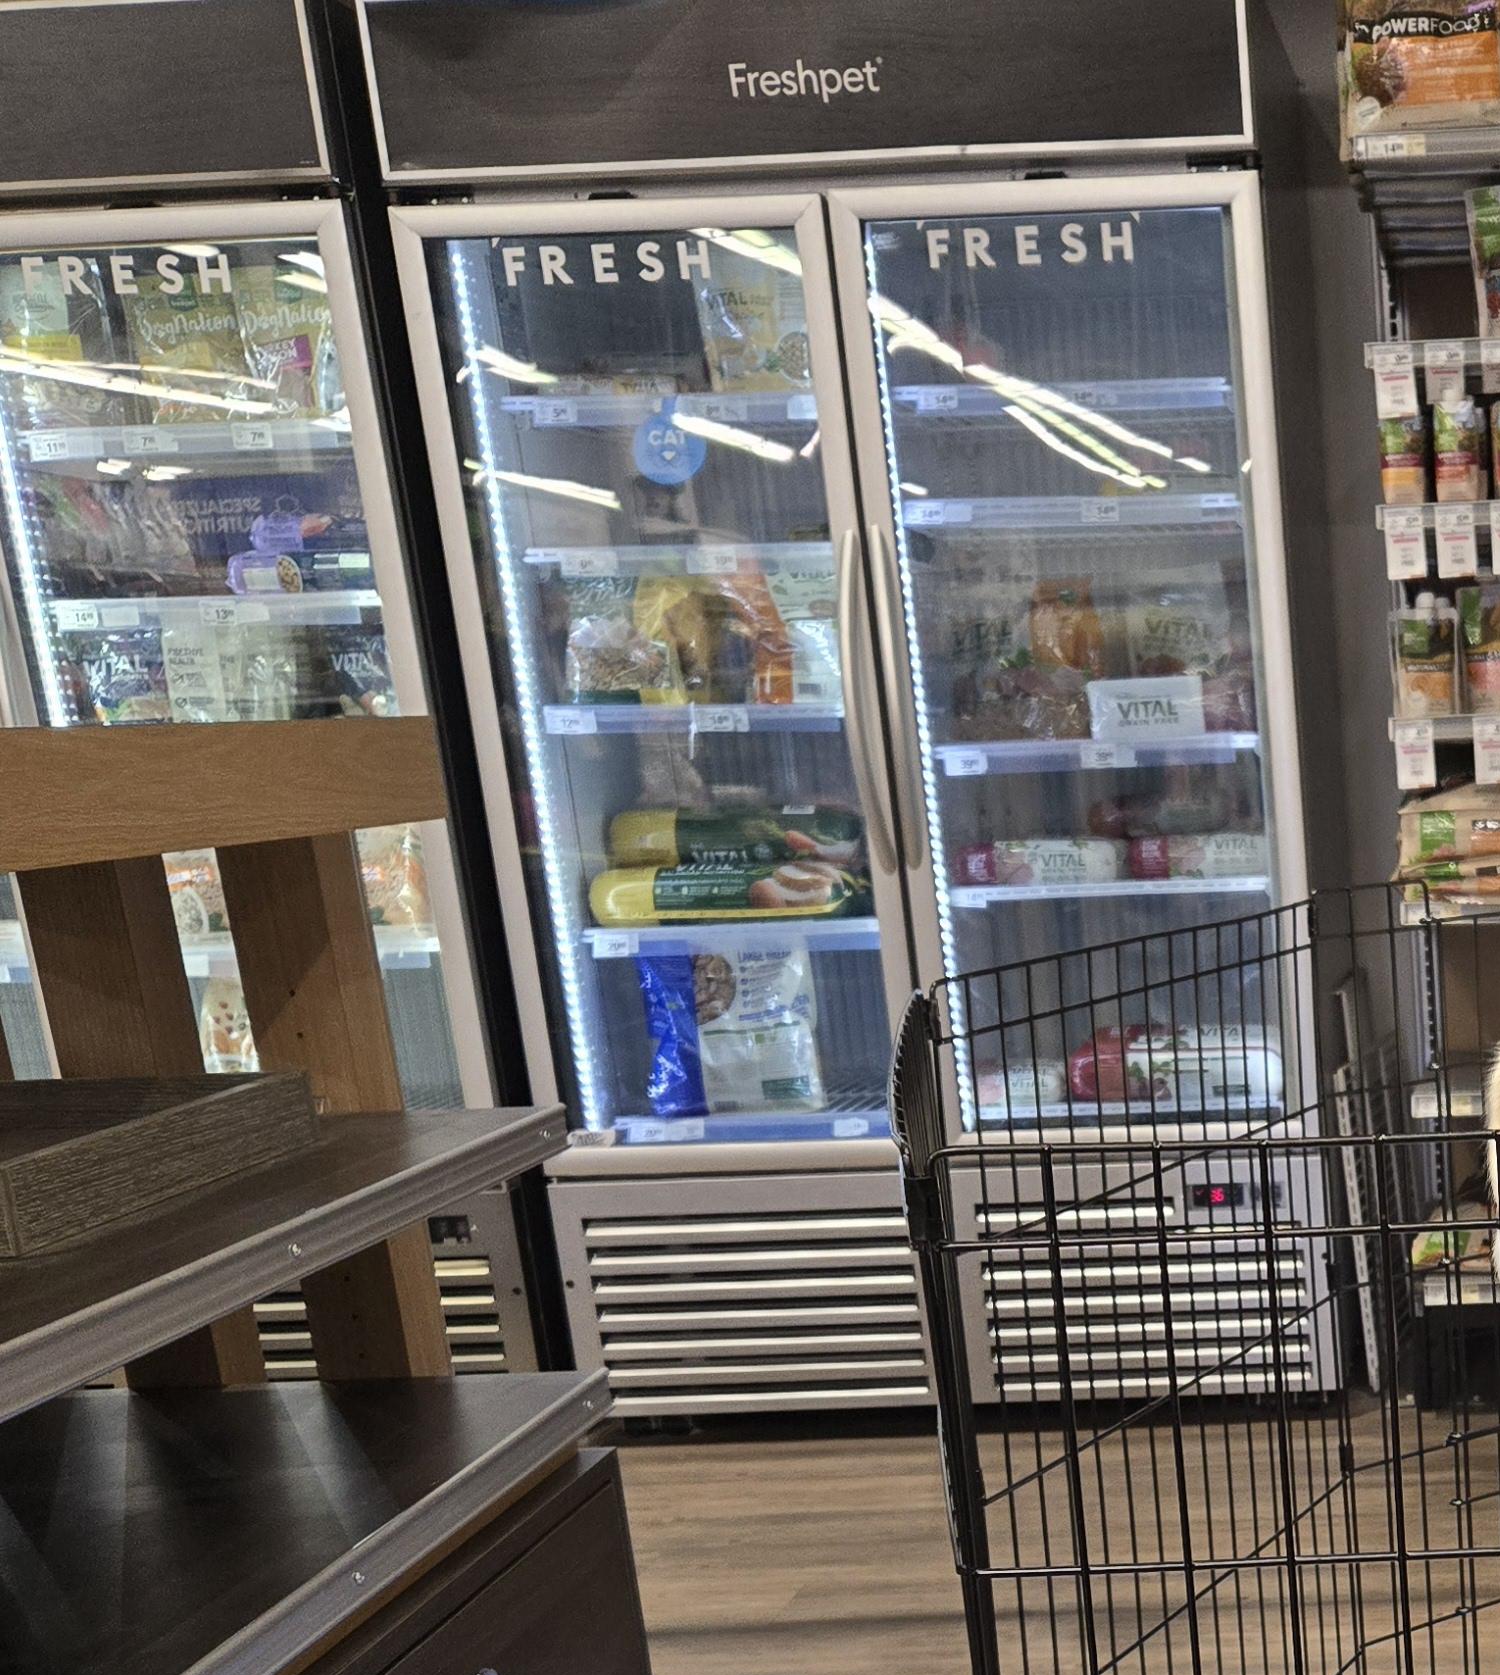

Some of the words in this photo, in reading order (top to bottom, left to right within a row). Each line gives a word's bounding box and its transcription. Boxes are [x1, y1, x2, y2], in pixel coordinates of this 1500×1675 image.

[729, 60, 882, 103] Freshpet
[502, 239, 712, 287] FRESH
[926, 222, 1135, 270] FRESH
[21, 253, 232, 296] FRESH
[1117, 699, 1179, 718] VITAL
[1040, 852, 1087, 868] VITAL
[1213, 837, 1258, 851] VITAL
